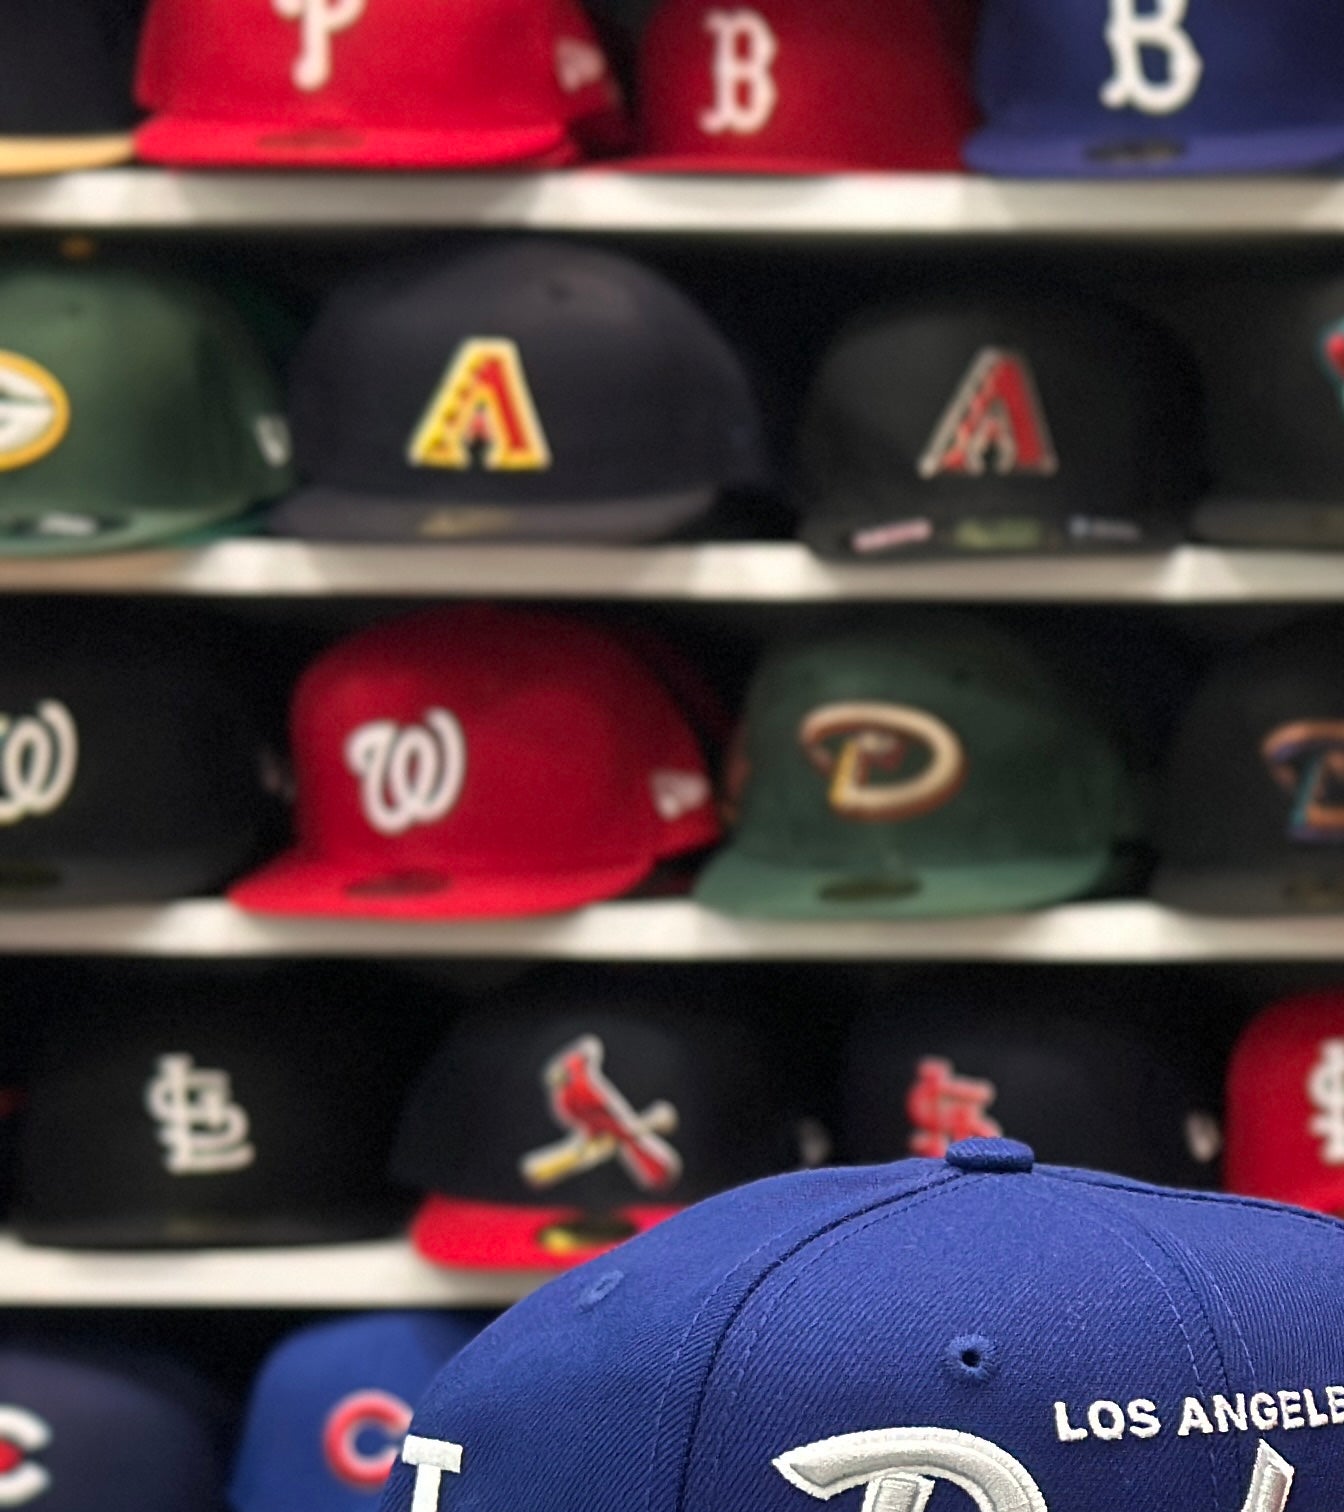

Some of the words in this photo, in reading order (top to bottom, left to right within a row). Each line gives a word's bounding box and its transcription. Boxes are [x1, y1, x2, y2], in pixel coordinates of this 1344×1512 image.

[698, 9, 779, 134] B
[1100, 0, 1203, 115] B
[408, 337, 552, 471] A
[917, 347, 1058, 478] A
[344, 706, 467, 836] W
[1054, 1398, 1162, 1443] LOS
